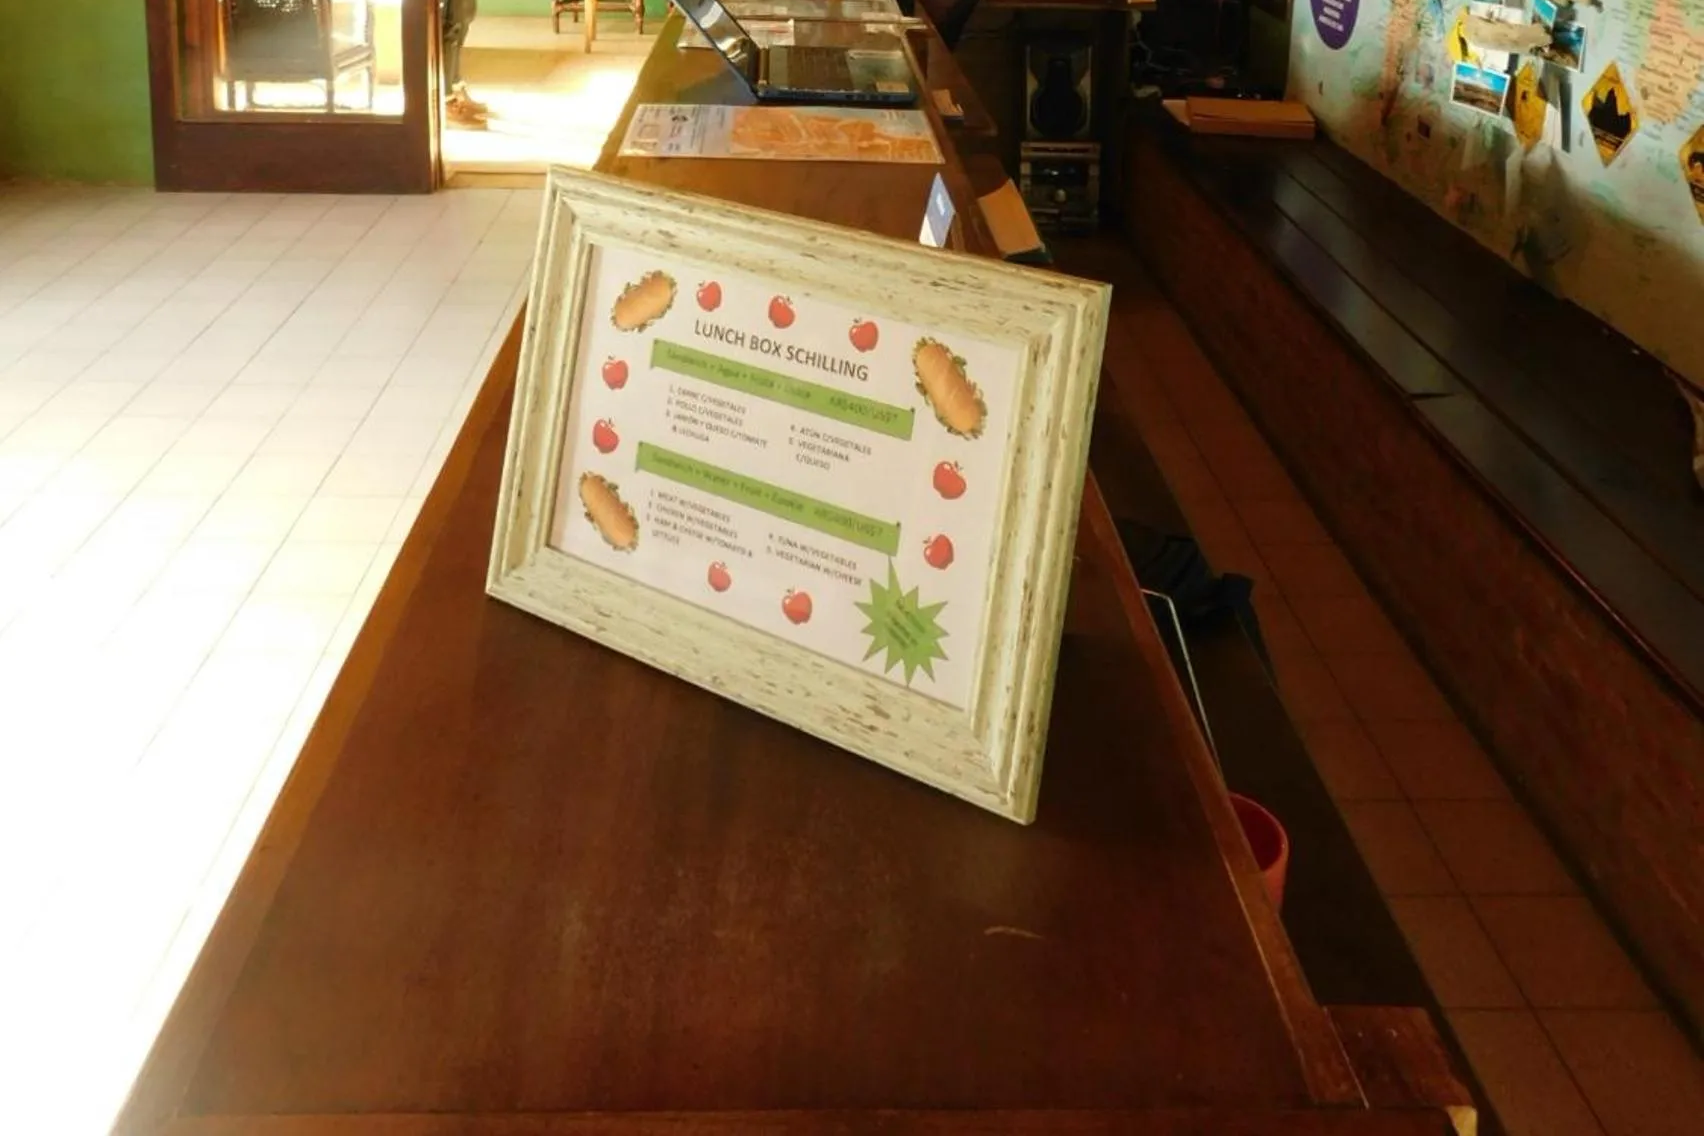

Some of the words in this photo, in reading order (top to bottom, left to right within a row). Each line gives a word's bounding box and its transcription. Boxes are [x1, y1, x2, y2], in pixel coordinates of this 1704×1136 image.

[693, 319, 746, 348] LUNCH
[748, 334, 783, 358] BOX
[784, 344, 870, 382] SCHILLING
